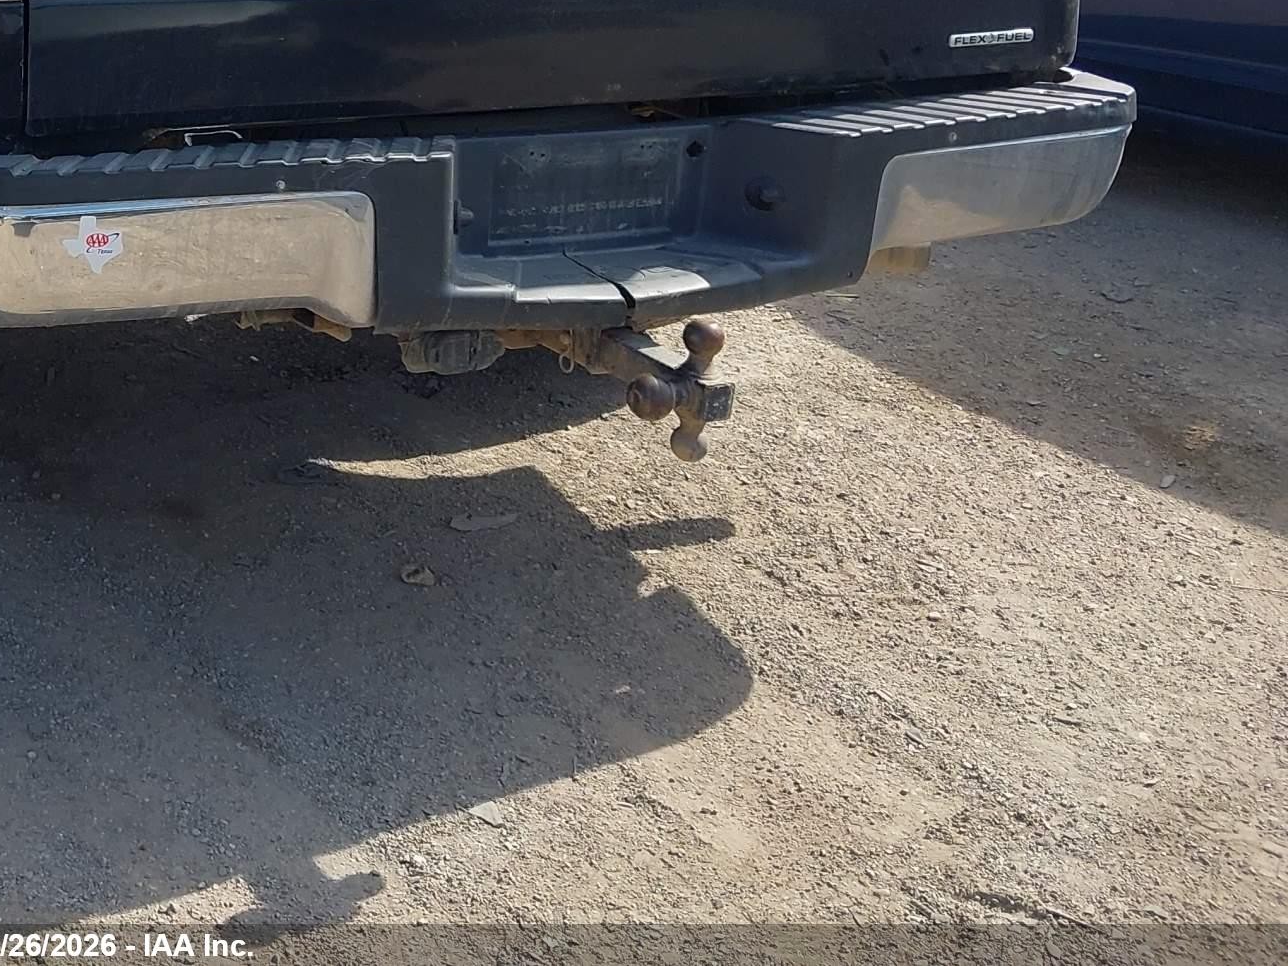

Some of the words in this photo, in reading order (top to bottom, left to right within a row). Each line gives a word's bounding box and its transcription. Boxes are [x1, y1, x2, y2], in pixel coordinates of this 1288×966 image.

[954, 34, 987, 46] FLEX
[996, 31, 1032, 43] FUEL
[87, 233, 109, 248] AAA
